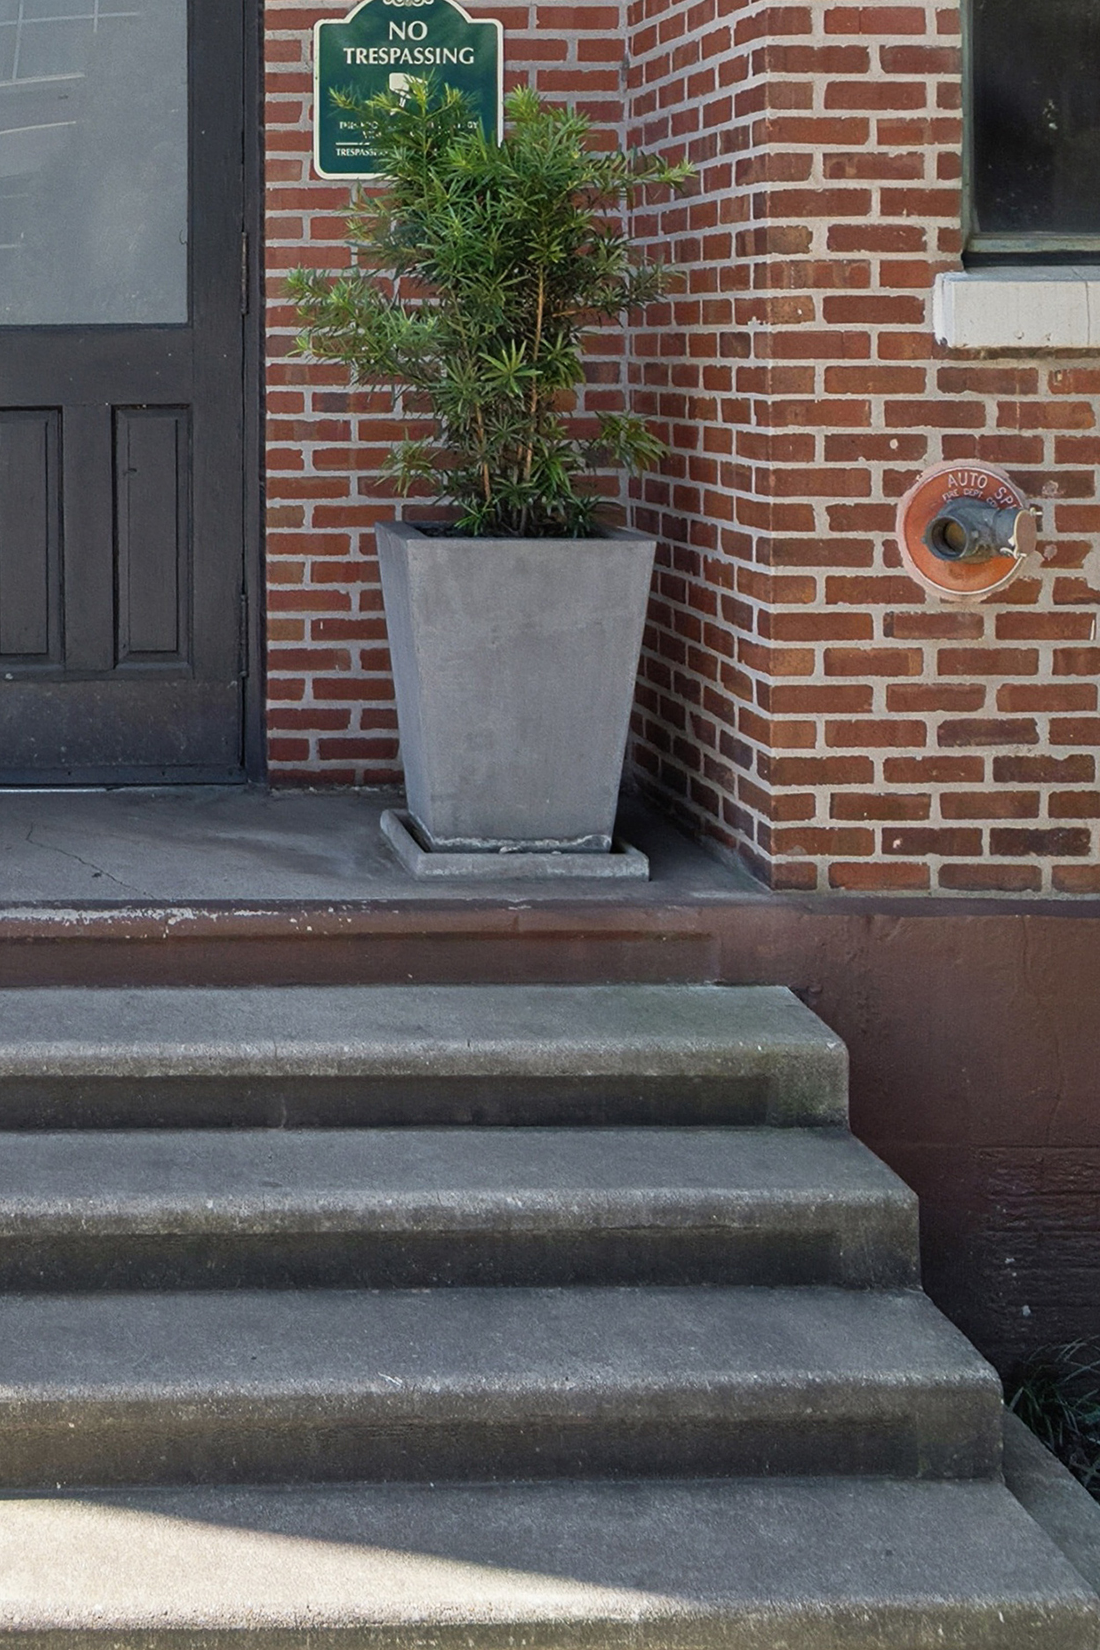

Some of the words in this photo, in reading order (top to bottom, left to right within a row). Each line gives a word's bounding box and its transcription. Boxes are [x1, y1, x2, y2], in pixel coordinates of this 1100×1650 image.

[389, 21, 428, 41] NO
[343, 47, 475, 65] TRESPASSING
[947, 471, 989, 489] AUTO
[942, 488, 960, 501] FIRE
[963, 488, 984, 498] DEPT
